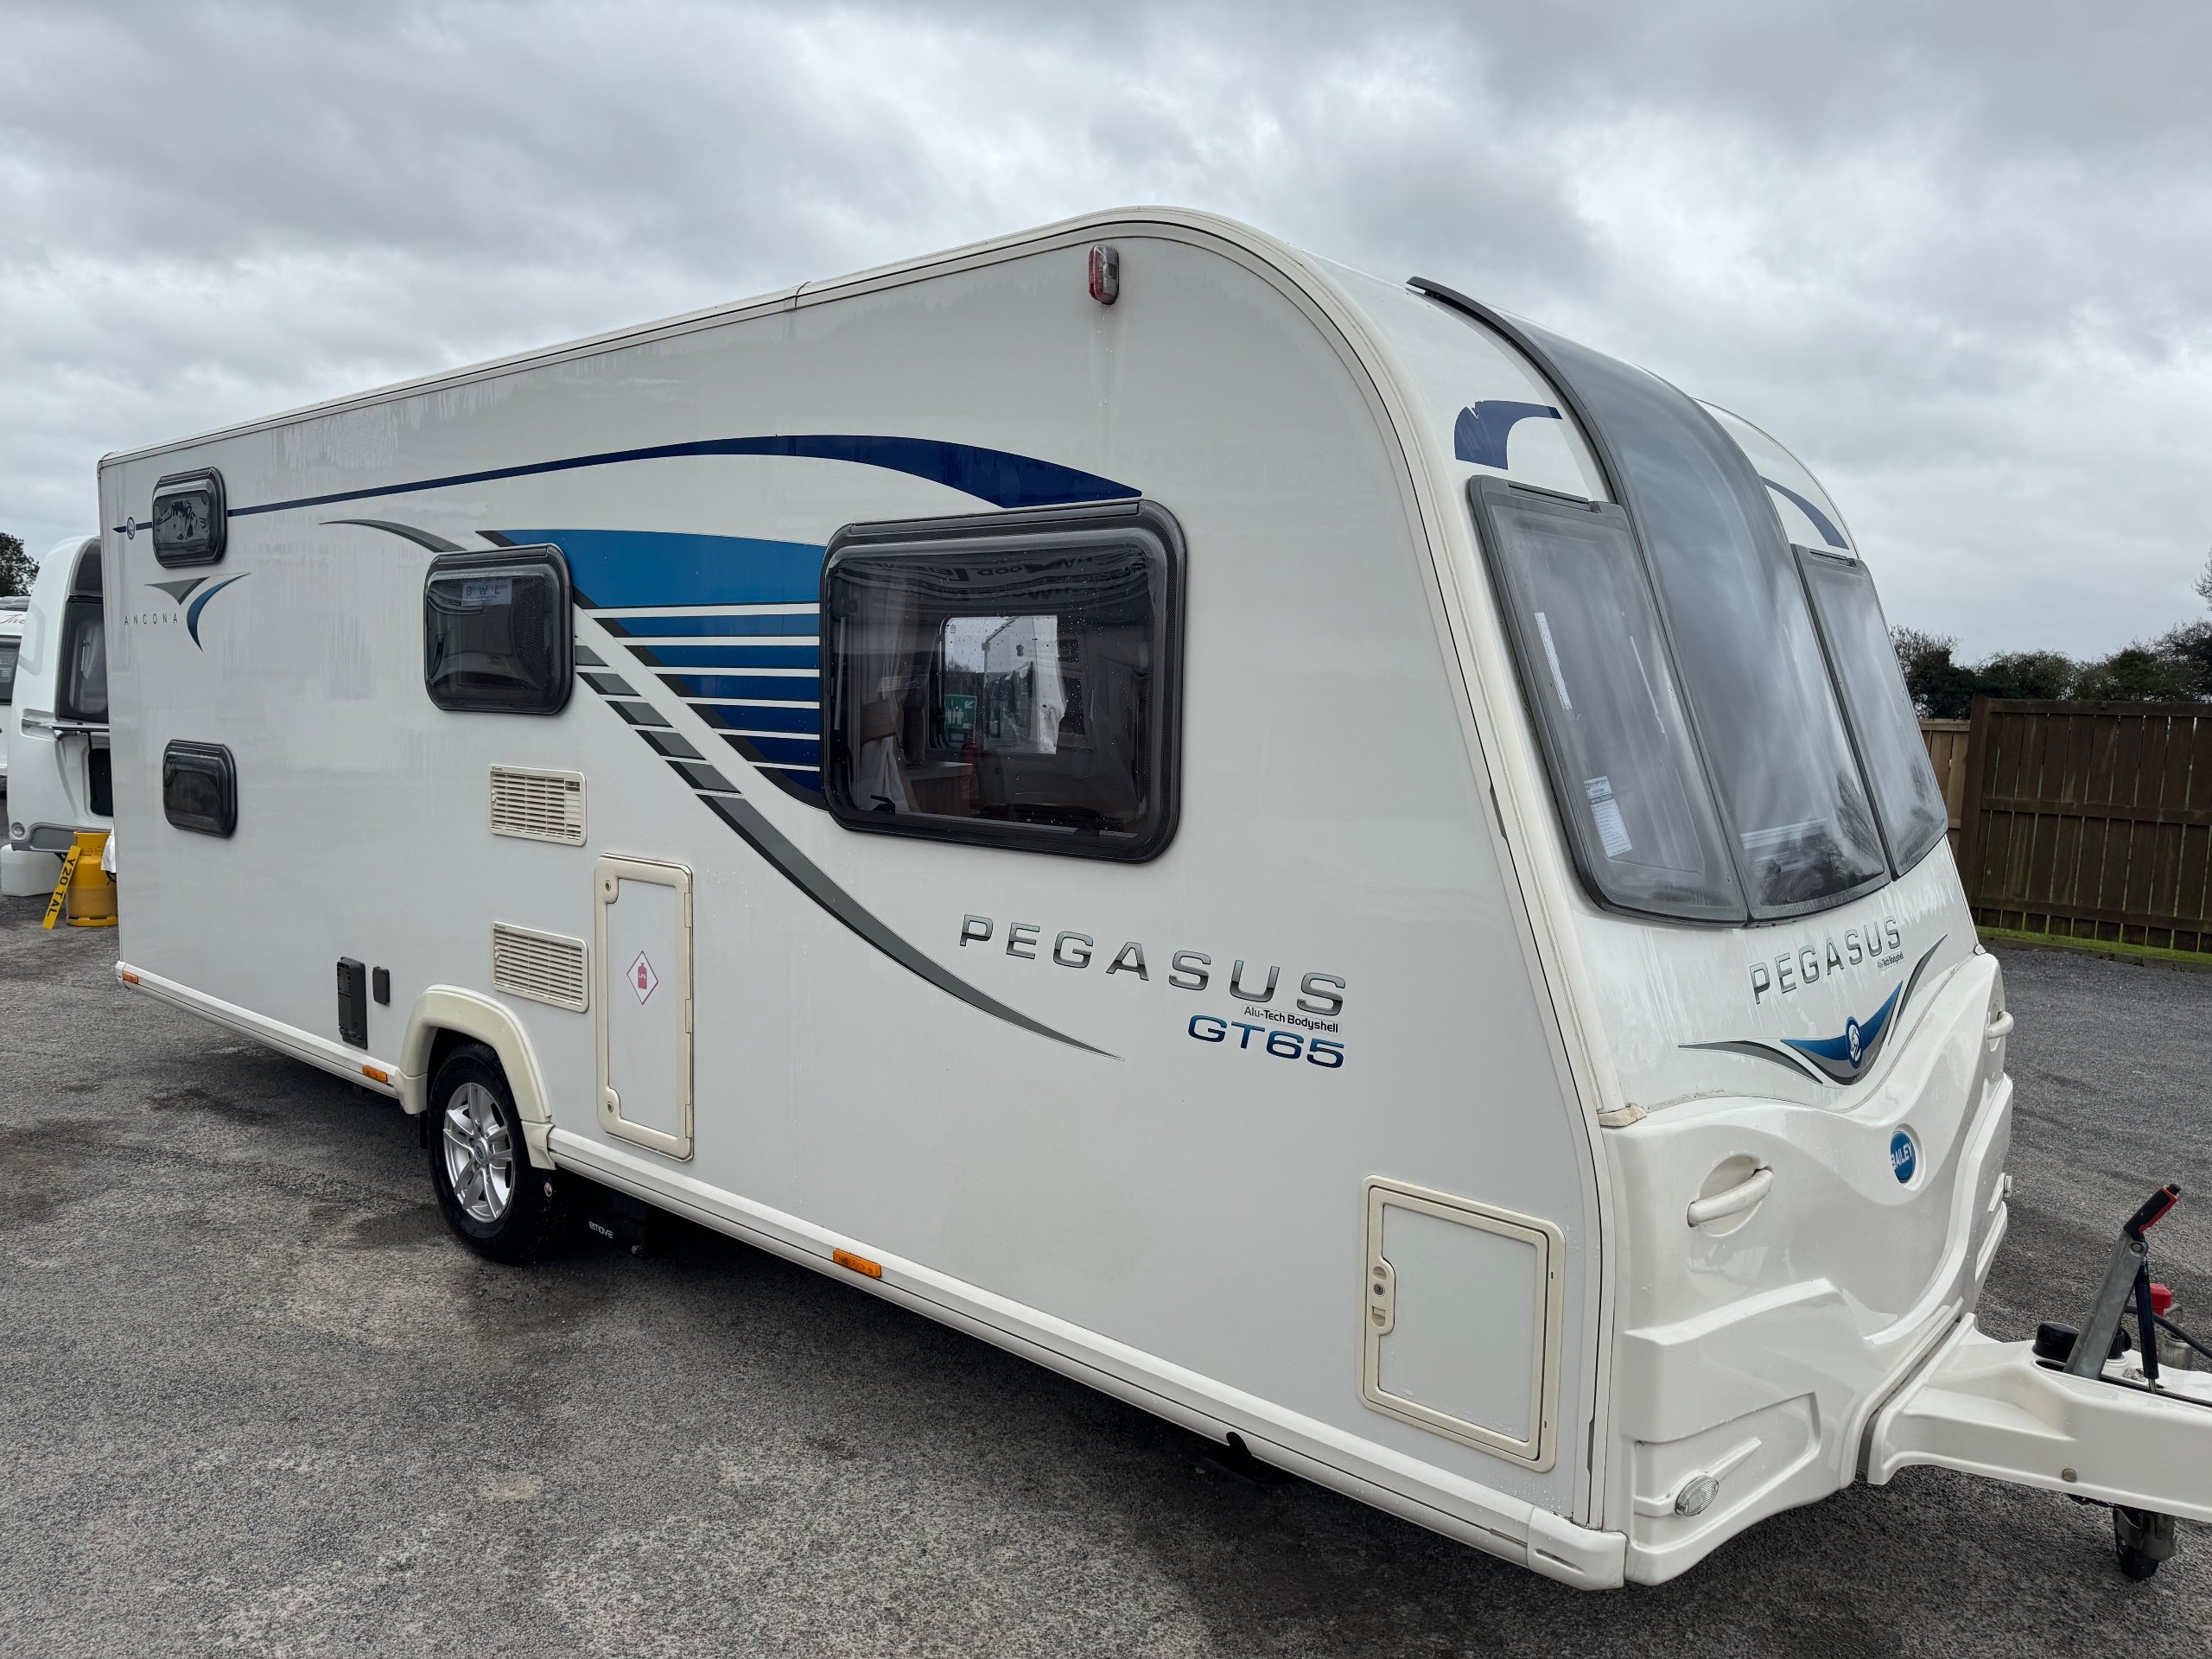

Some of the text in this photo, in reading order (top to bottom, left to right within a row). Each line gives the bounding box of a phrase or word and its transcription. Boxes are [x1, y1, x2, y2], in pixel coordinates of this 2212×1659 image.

[124, 612, 178, 626] ANCONA
[47, 890, 65, 917] TAL
[959, 913, 1346, 1017] PEGASUS
[1749, 915, 1902, 1005] PEGASUS
[1243, 1006, 1338, 1033] Alu-Tech Bodyshell
[1187, 1014, 1344, 1069] GT65
[1891, 1141, 1913, 1170] BAILEY
